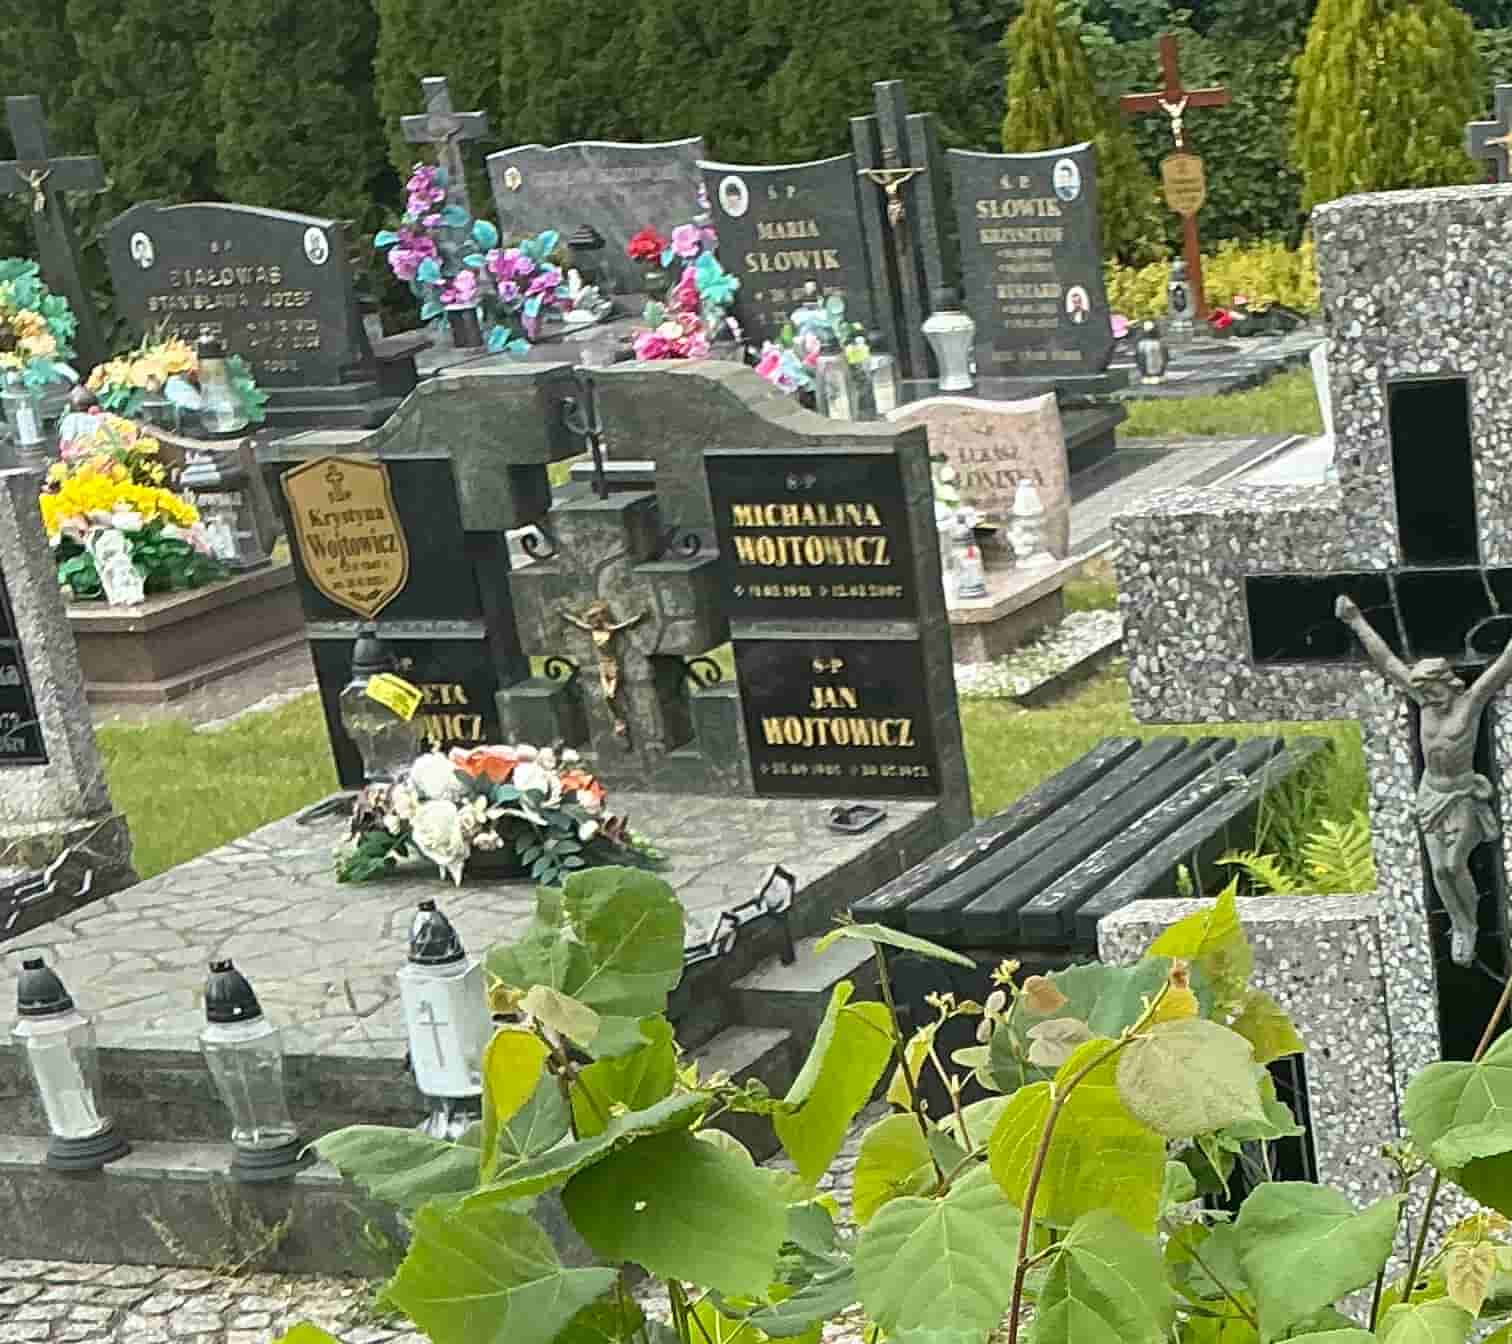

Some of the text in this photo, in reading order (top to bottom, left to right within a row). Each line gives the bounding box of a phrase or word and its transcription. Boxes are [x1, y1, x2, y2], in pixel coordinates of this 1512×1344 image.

[975, 199, 1063, 218] SŁOWIK
[744, 249, 841, 273] SŁOWIK
[308, 506, 385, 530] Krystyna
[732, 503, 882, 527] MICHALINA
[810, 687, 858, 709] JAN
